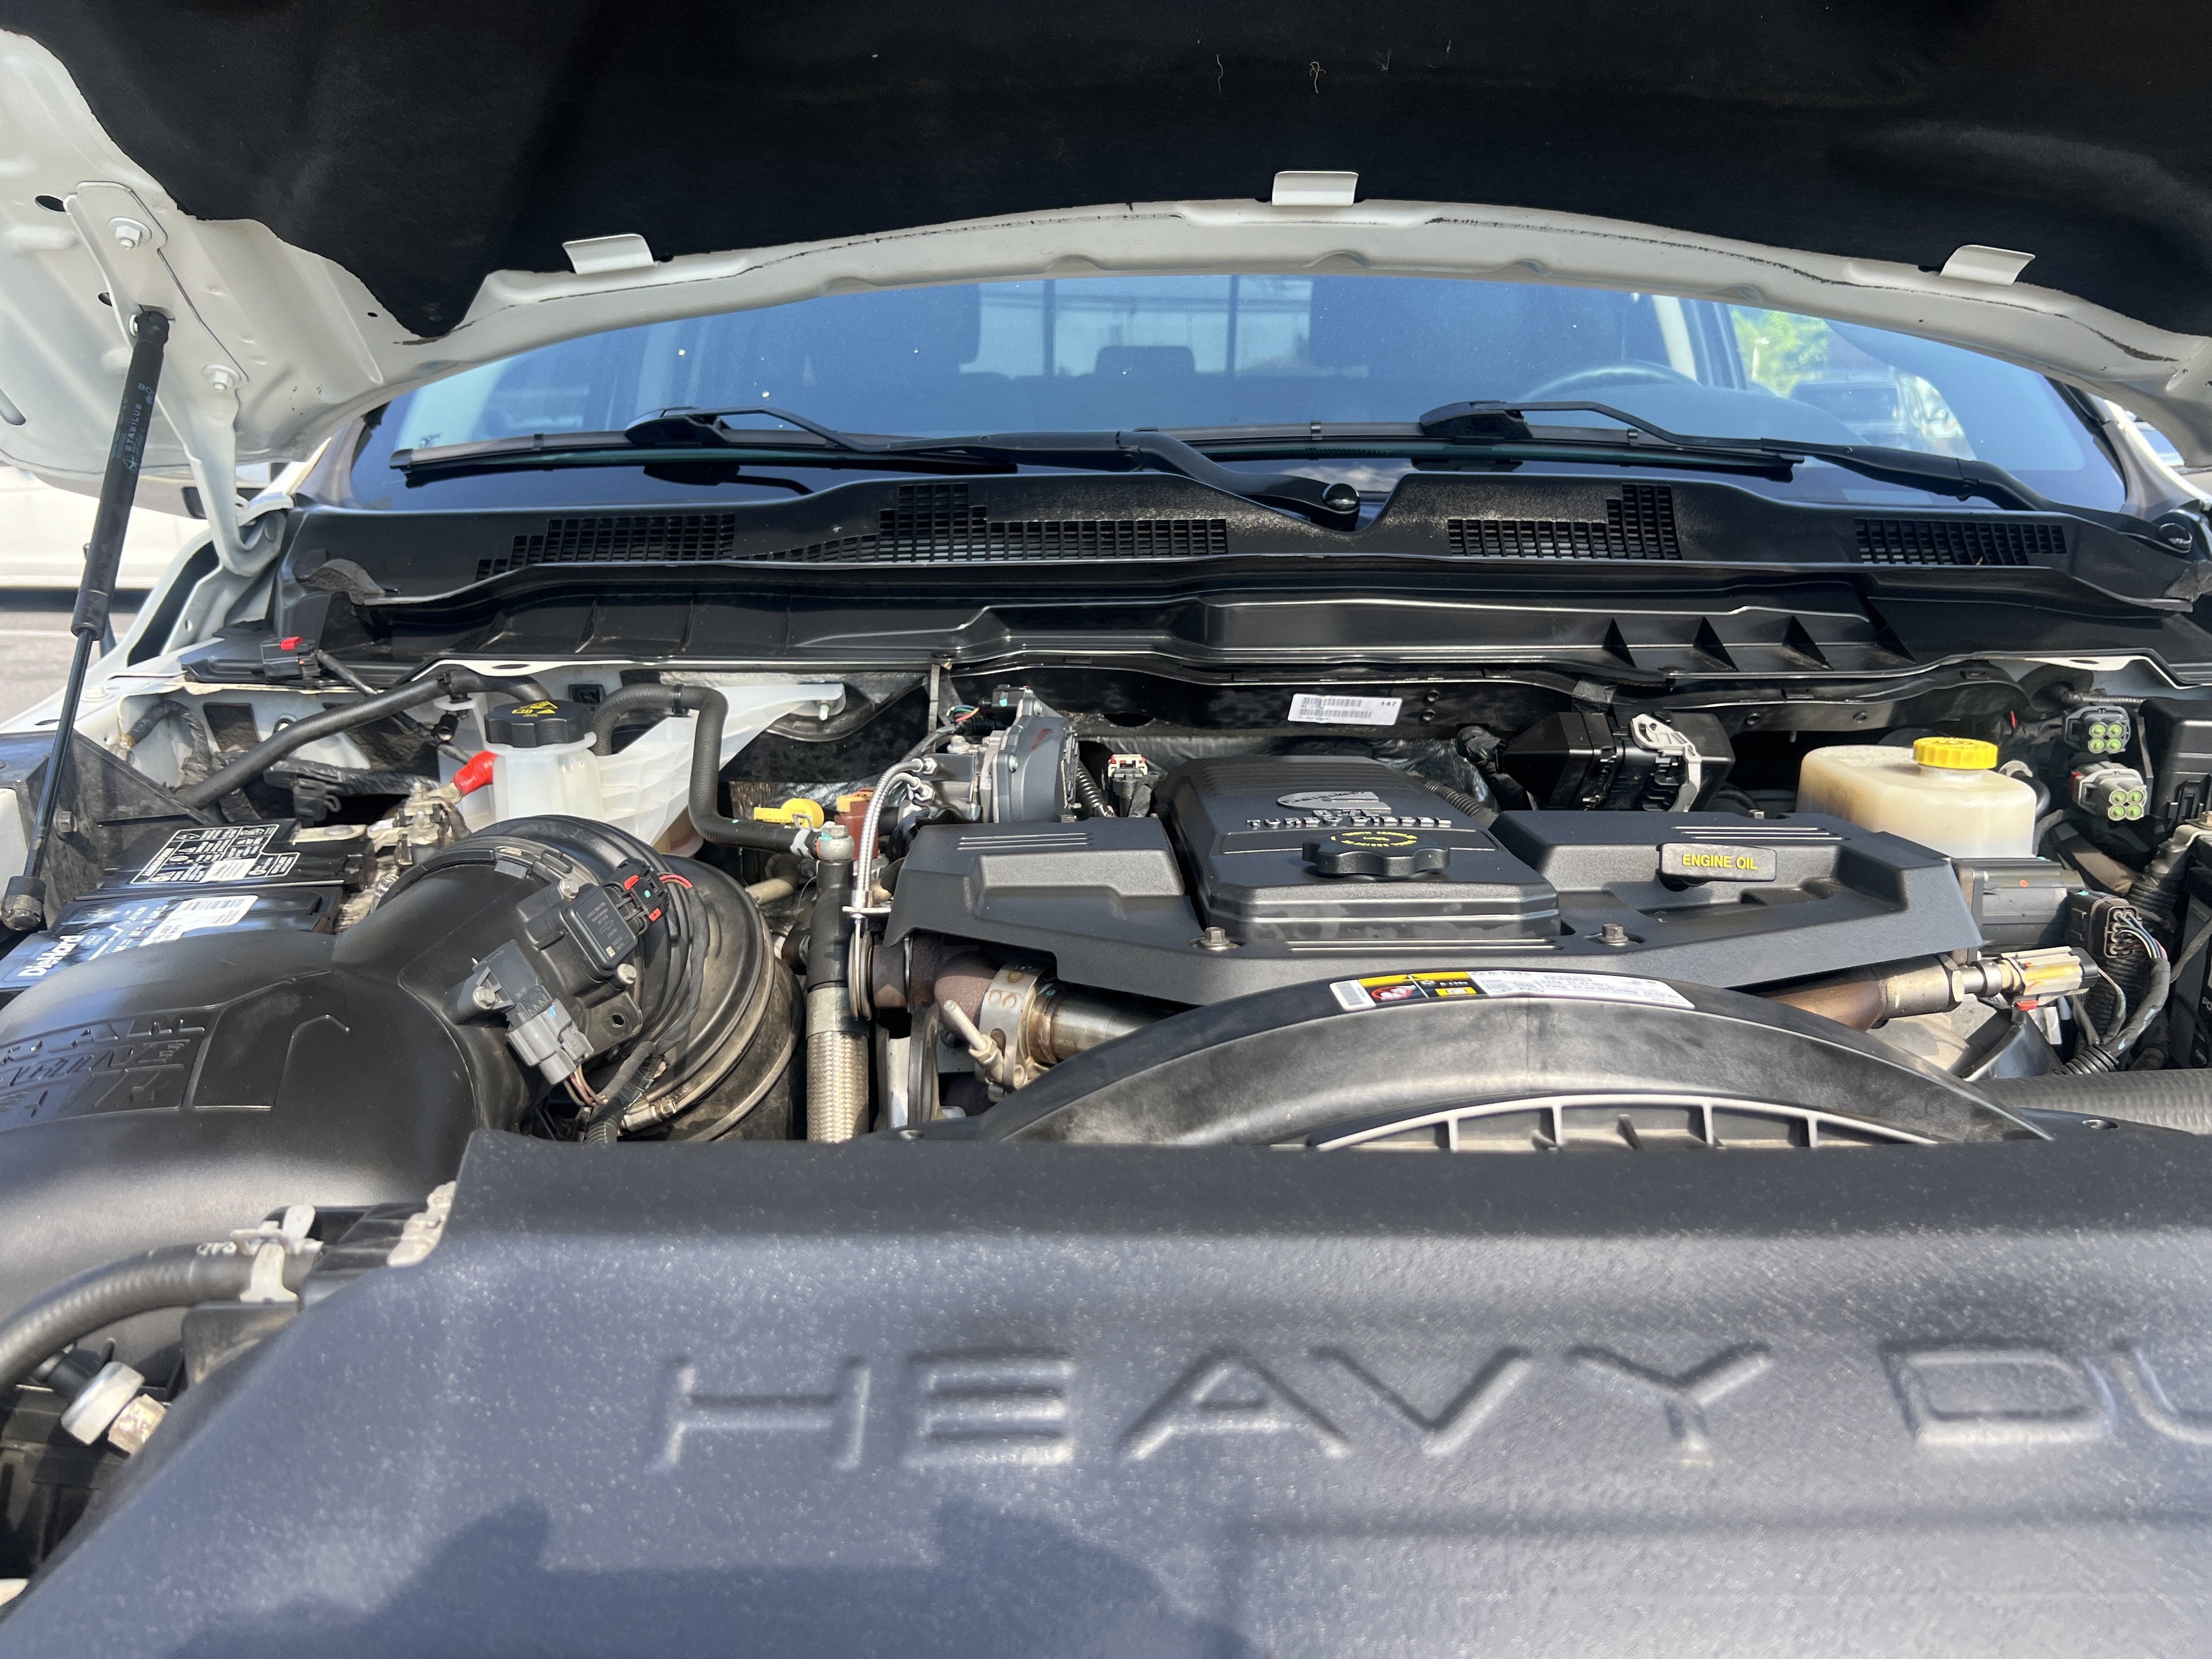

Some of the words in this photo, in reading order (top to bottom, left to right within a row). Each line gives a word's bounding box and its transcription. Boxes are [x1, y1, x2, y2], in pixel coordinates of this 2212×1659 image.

[125, 403, 142, 452] STABILUS
[1246, 816, 1342, 829] TURBO
[1348, 815, 1452, 828] DIESEL
[1683, 854, 1732, 868] ENGINE
[1736, 856, 1757, 870] OIL
[17, 935, 85, 977] DieHard
[653, 1343, 1776, 1471] HEAVY
